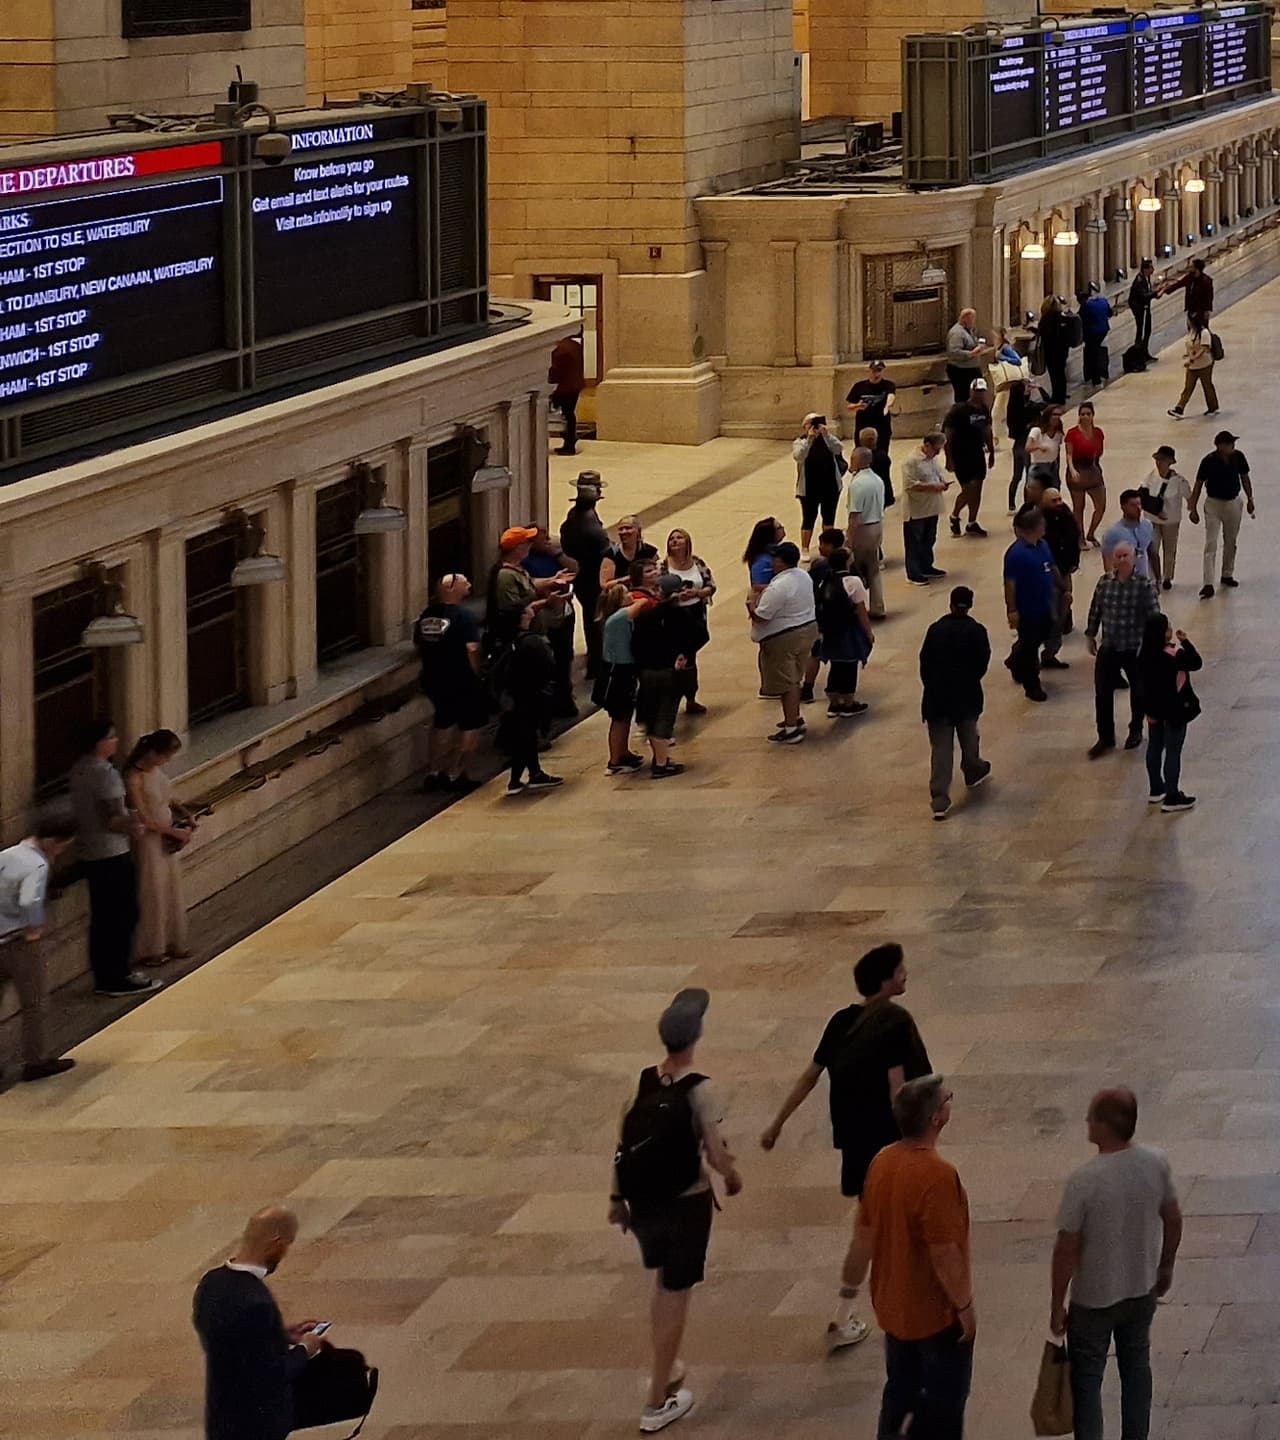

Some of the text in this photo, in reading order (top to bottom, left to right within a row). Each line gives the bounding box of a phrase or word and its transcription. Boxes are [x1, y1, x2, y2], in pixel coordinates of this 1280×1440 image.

[291, 124, 374, 150] INFORMATION
[19, 156, 136, 191] DEPARTURES
[294, 158, 375, 182] Know before you go
[252, 174, 409, 213] Get email and text alerts for your routes
[276, 216, 295, 231] Visit
[353, 203, 363, 217] to
[363, 200, 381, 218] sign
[381, 199, 393, 215] up
[44, 234, 60, 250] TO
[61, 229, 86, 247] SLE,
[86, 218, 152, 243] WATERBURY
[33, 261, 54, 279] 1ST
[55, 256, 86, 275] STOP
[7, 296, 23, 313] TO
[25, 285, 80, 309] DANBURY,
[80, 279, 107, 299] NEW
[107, 271, 153, 292] CANAAN,
[153, 256, 215, 281] WATERBURY
[34, 317, 56, 334] 1ST
[56, 309, 88, 329] STOP
[48, 340, 69, 358] 1ST
[69, 332, 100, 352] STOP
[0, 378, 28, 398] HAM
[35, 370, 57, 388] 1ST
[57, 362, 89, 382] STOP
